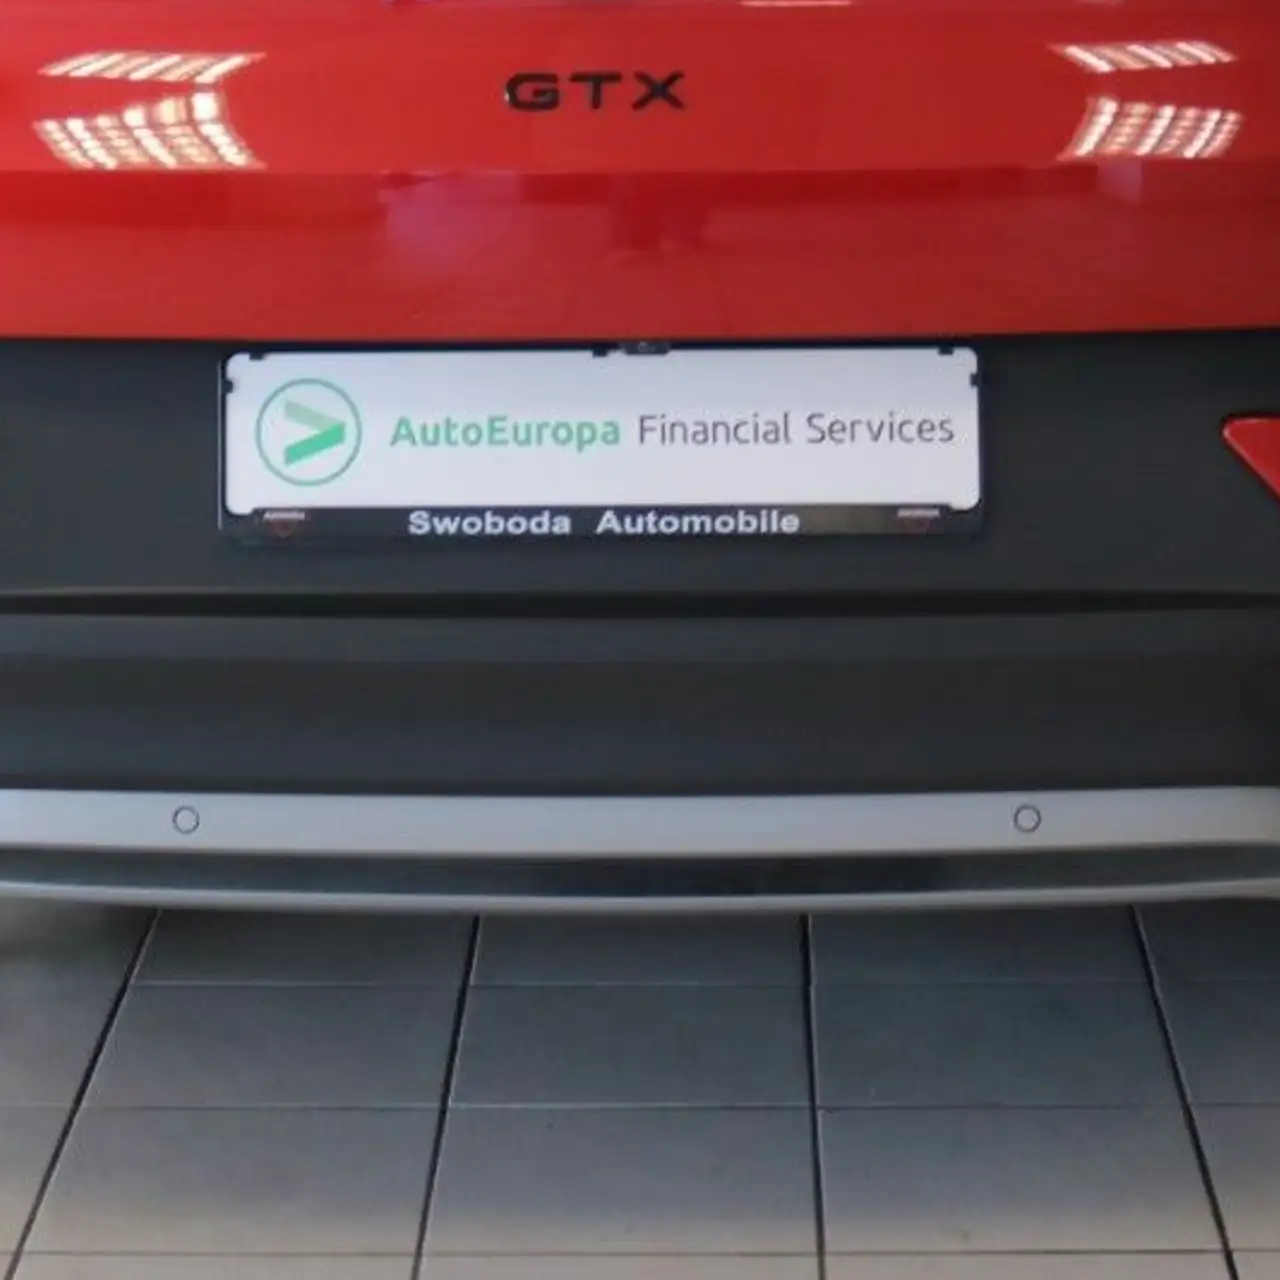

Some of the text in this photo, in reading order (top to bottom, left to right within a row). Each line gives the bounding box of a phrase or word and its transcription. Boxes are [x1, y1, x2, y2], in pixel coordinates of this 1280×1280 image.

[505, 72, 686, 111] GTX
[390, 411, 955, 453] AutoEuropa Financial Services
[408, 508, 801, 536] Swoboda Automobile
